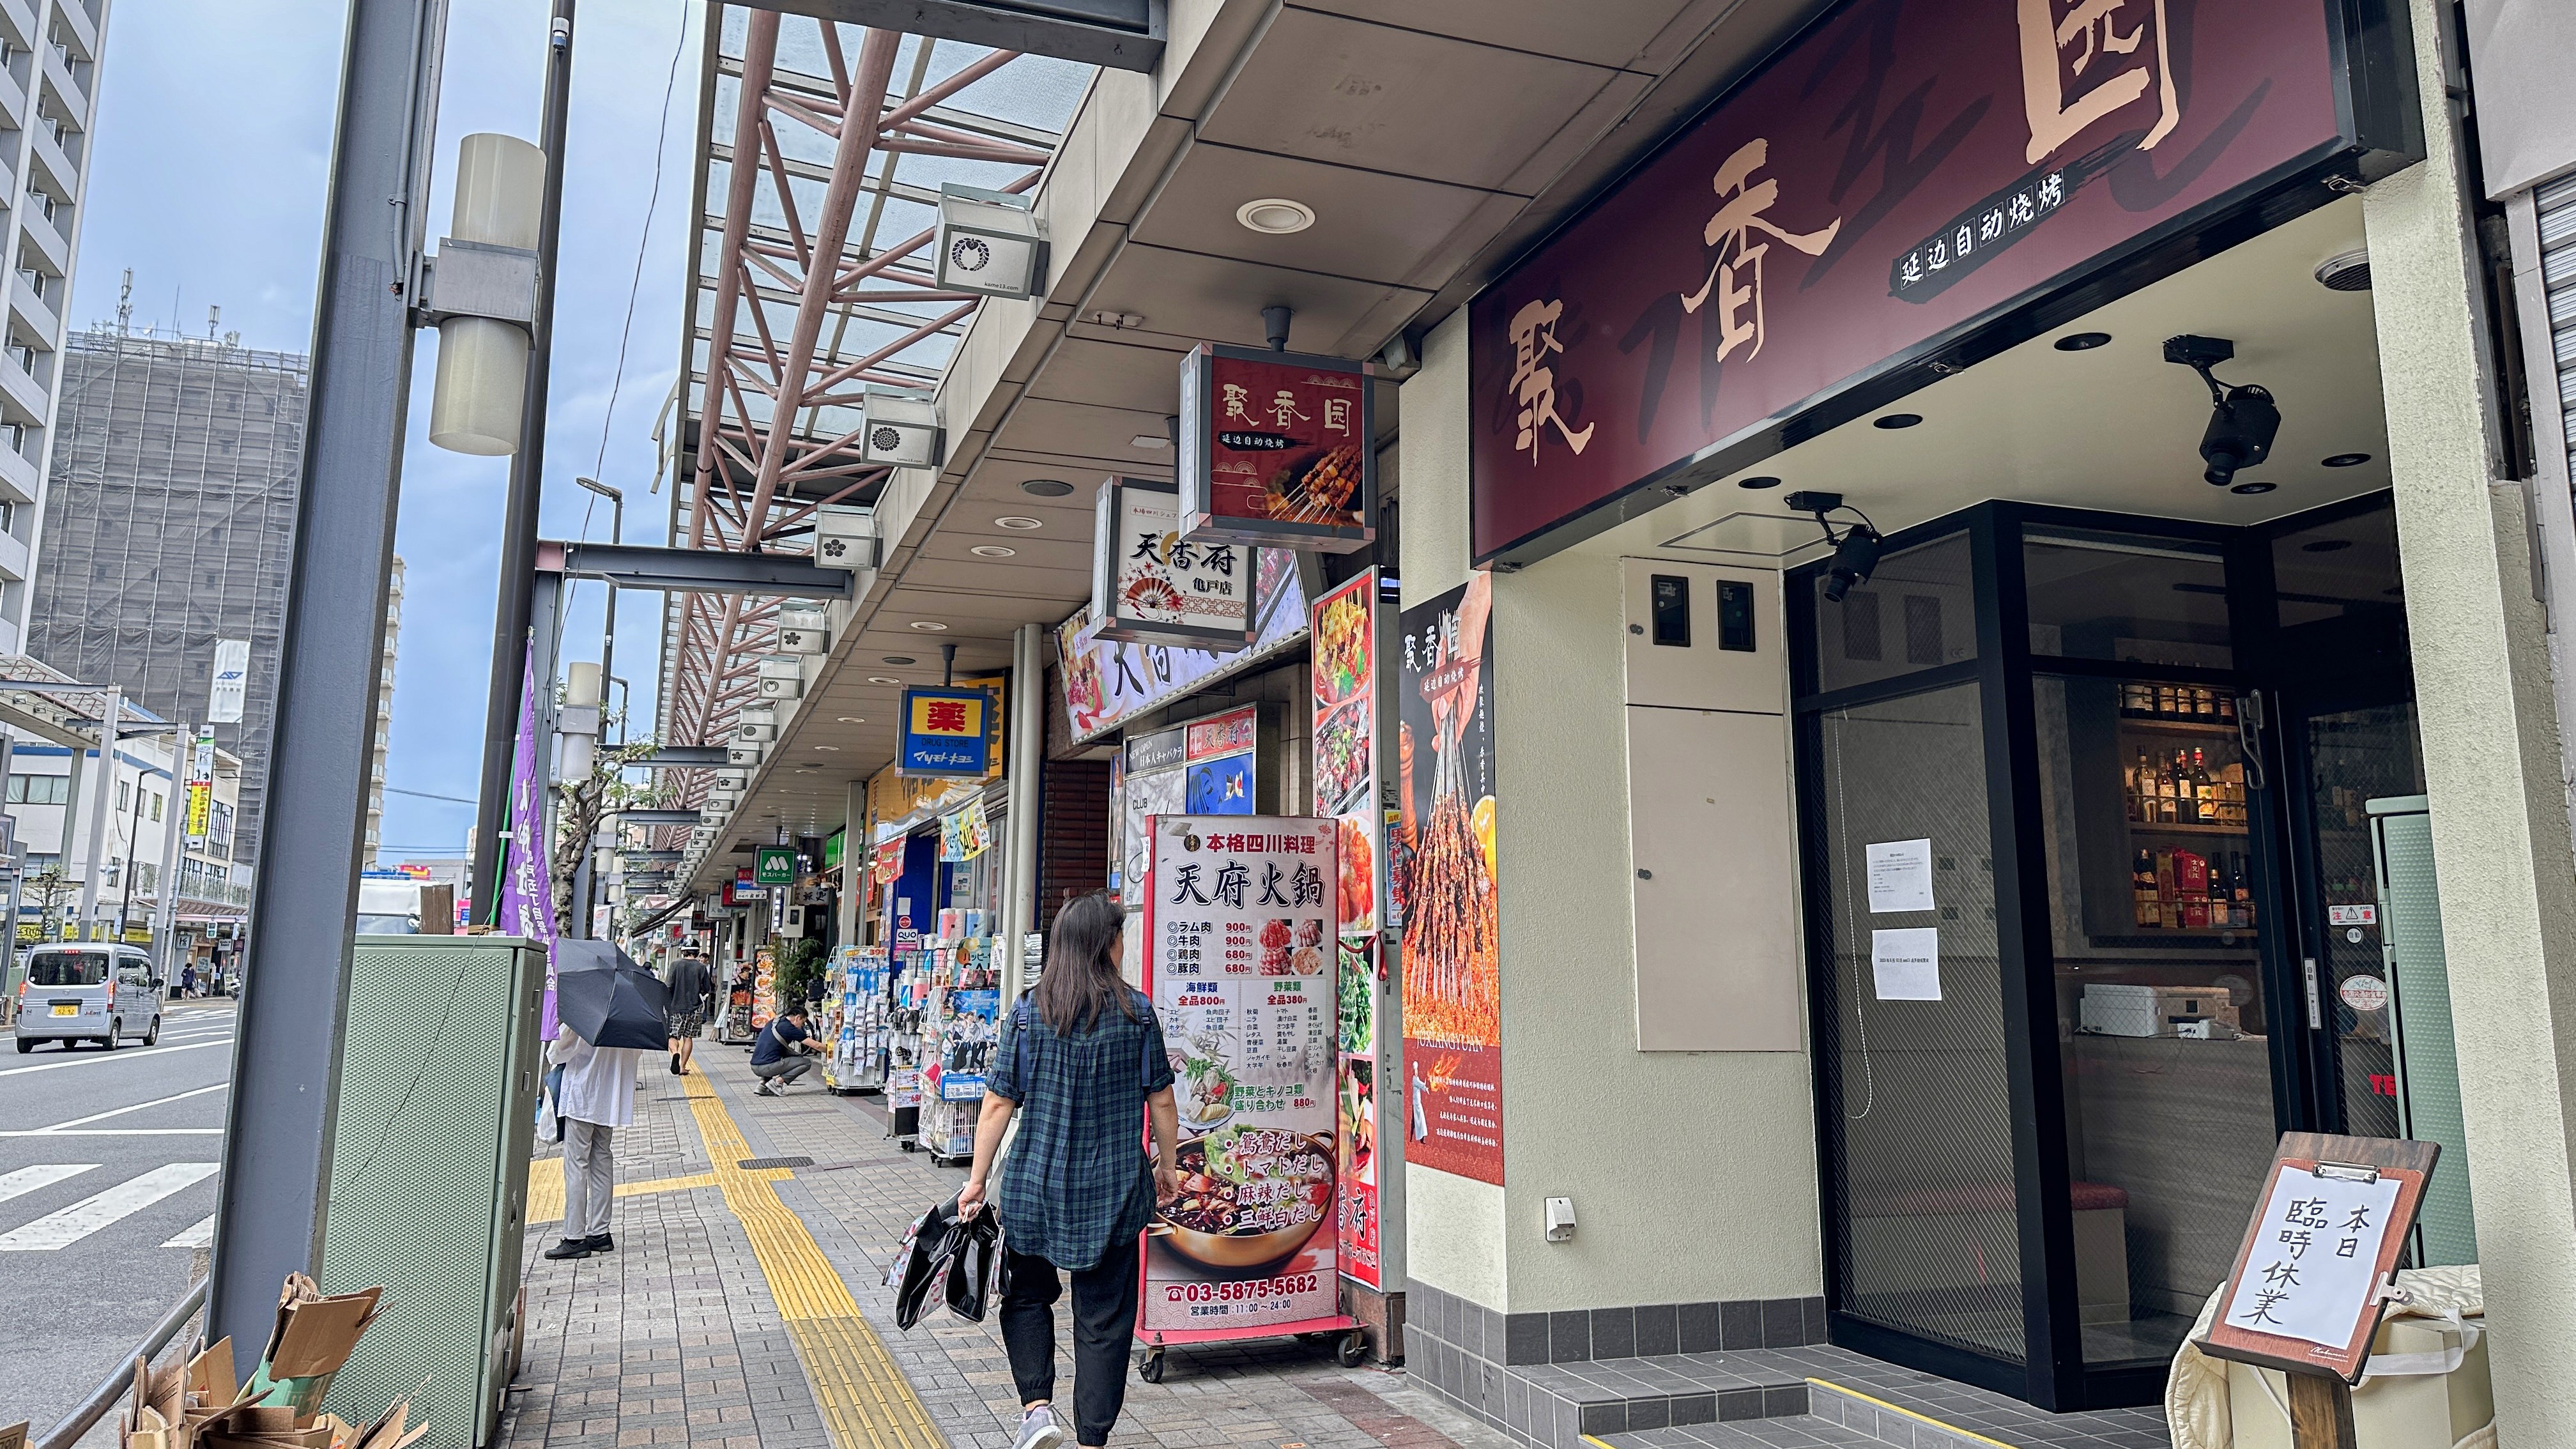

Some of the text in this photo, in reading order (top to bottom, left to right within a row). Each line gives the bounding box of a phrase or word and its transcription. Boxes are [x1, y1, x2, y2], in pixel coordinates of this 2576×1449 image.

[1900, 169, 2066, 290] 延边自动烧烤
[985, 282, 1018, 291] kame13.com
[1223, 383, 1352, 438] 聚香园
[1222, 433, 1285, 449] 延边自动烧烤
[1130, 533, 1238, 576] 天香府
[1423, 666, 1464, 693] 延边自动烧烤
[926, 701, 967, 732] 薬
[921, 737, 969, 747] DRUG STORE
[913, 751, 974, 765] マツモトキヨシ
[1128, 739, 1153, 762] NEW OPEN
[1139, 746, 1183, 767] 日本人キャバクラ
[1132, 797, 1148, 810] CLUB
[1388, 813, 1402, 823] 高収
[1206, 833, 1316, 855] 本格四川料理
[1170, 858, 1326, 909] 天府火鍋
[2332, 910, 2342, 921] 注
[898, 930, 917, 939] QUO
[1177, 921, 1253, 935] ラム肉 900円
[1177, 935, 1253, 947] 牛肉 900円
[963, 952, 991, 962] ハッピー
[1177, 948, 1253, 961] 鶏肉 680円
[1177, 963, 1252, 975] 豚肉 680円
[1186, 981, 1218, 993] 海鮮類
[1273, 981, 1301, 992] 野菜類
[1177, 995, 1225, 1006] 全品800円
[1267, 994, 1308, 1006] 全品380円
[1416, 1030, 1483, 1053] JUXIANGYUAN
[1234, 1083, 1305, 1100] 野菜とキノコ類
[1234, 1097, 1316, 1113] 盛り合わせ 880円
[1239, 1131, 1308, 1156] 鴛鴦だし
[1241, 1154, 1324, 1180] トマトだし
[1236, 1182, 1308, 1207] 麻辣だし
[1236, 1205, 1322, 1230] 三鮮白だし
[2336, 1204, 2370, 1259] 本日
[2239, 1196, 2329, 1326] 臨時休業
[1186, 1273, 1318, 1303] 03-5875-5682
